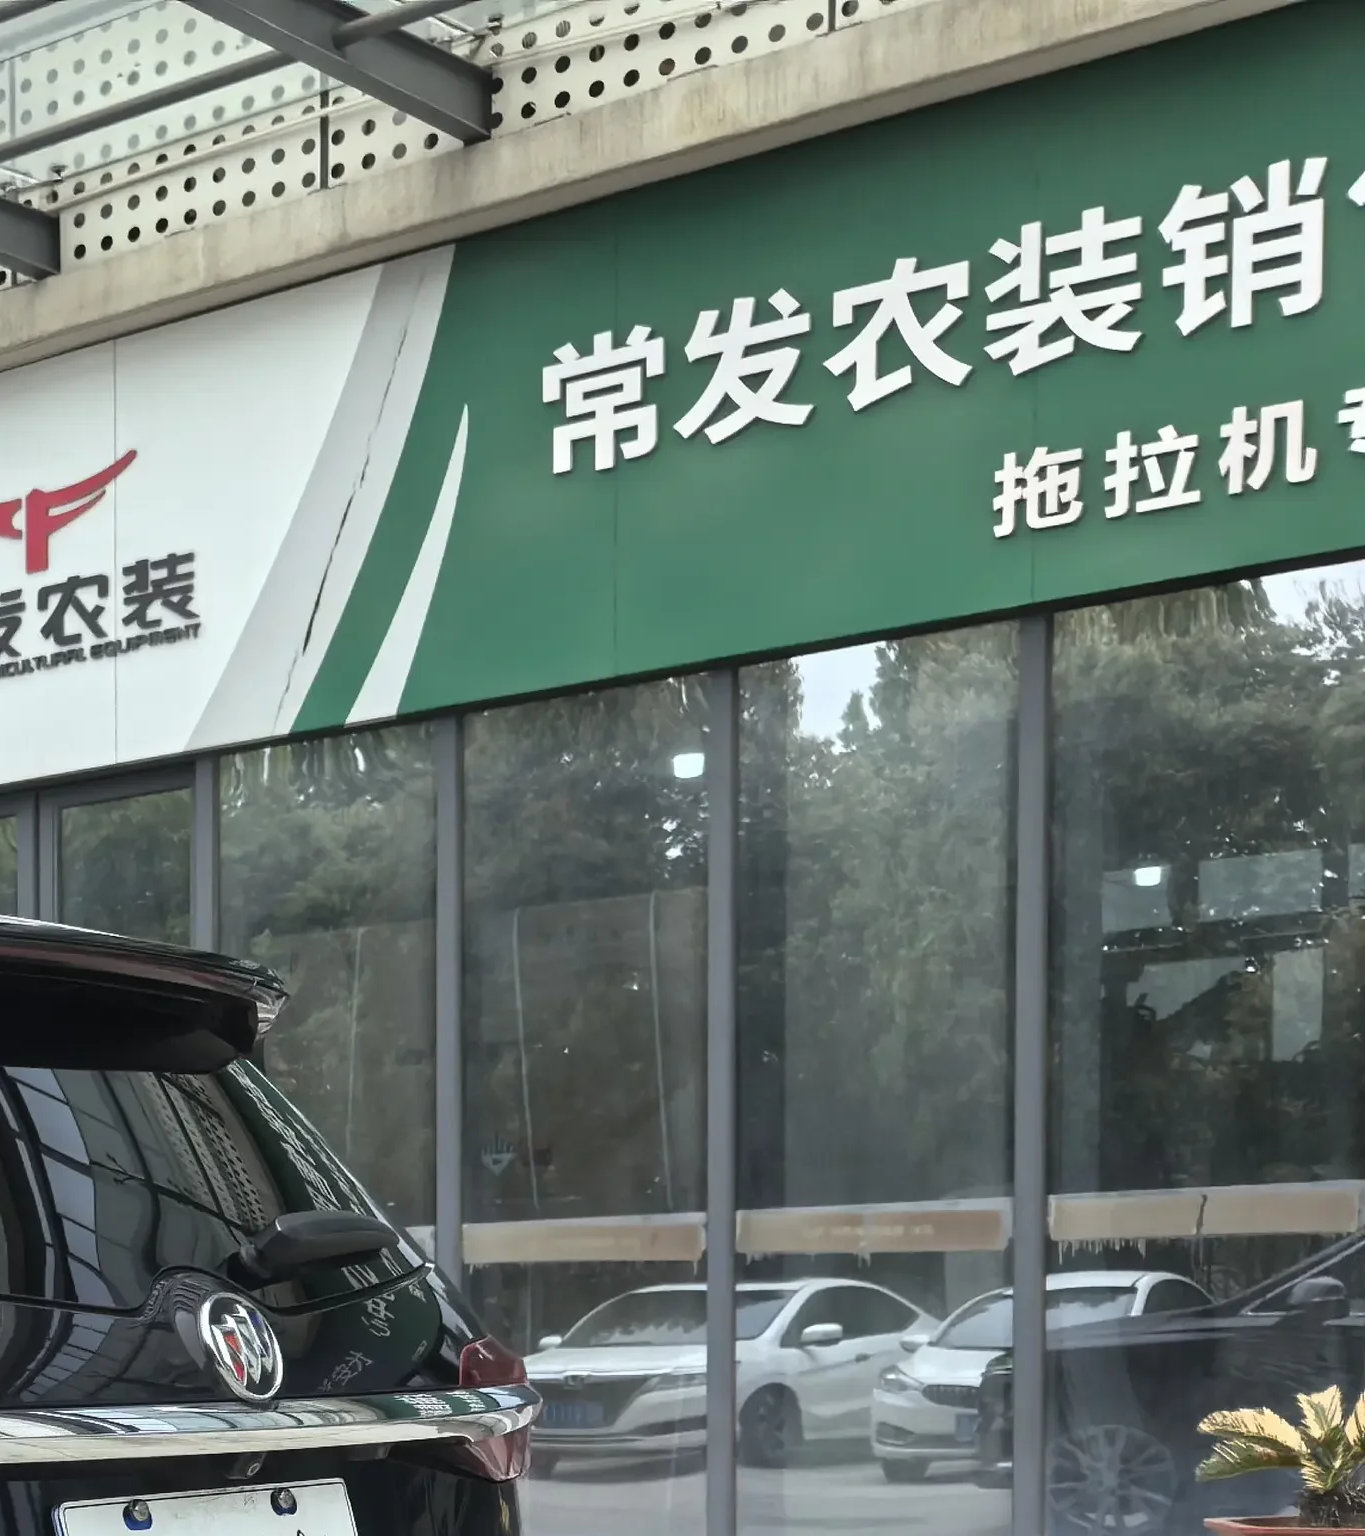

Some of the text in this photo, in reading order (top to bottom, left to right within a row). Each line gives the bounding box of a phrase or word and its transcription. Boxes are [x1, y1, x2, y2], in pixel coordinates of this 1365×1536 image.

[542, 157, 1365, 475] 常发农装销
